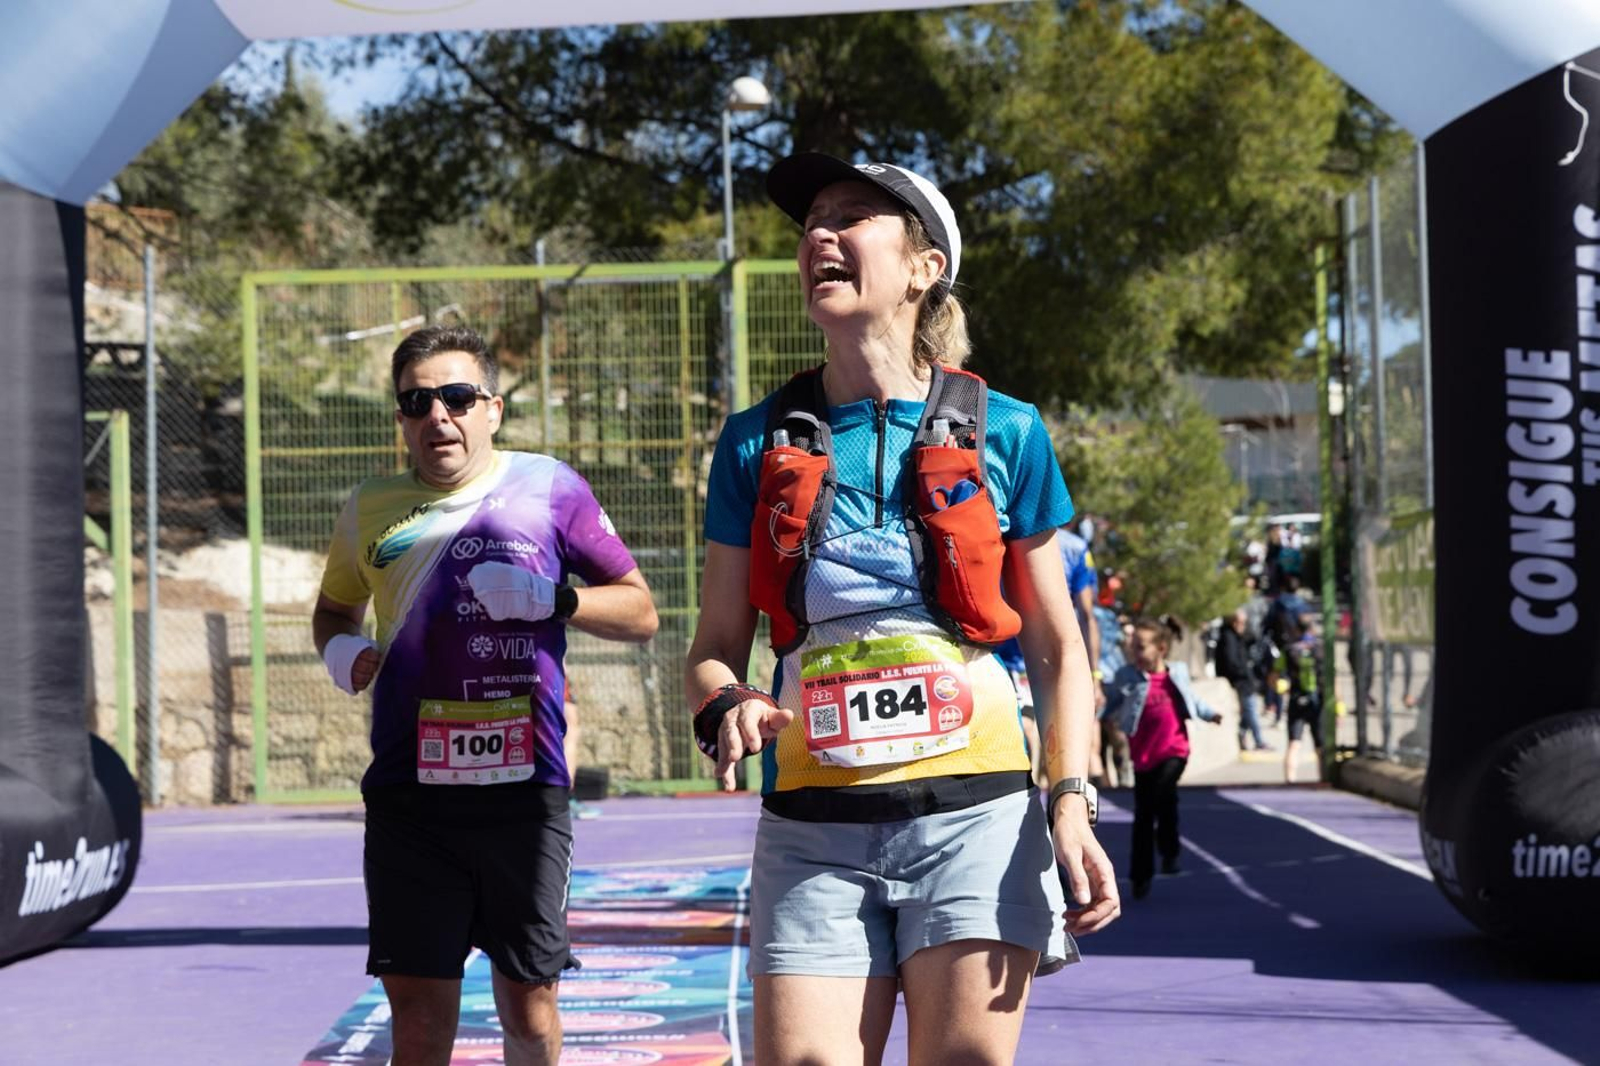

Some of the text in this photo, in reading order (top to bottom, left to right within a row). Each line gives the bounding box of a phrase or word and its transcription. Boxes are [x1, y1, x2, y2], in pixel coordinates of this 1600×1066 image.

[1505, 348, 1579, 635] CONSIGUE
[485, 539, 539, 554] Arrebola
[498, 637, 536, 660] VIDA
[817, 677, 837, 687] TRAIL
[840, 672, 880, 684] SOLIDARIO
[484, 690, 511, 699] HEMO
[850, 684, 928, 722] 184
[452, 733, 504, 756] 100
